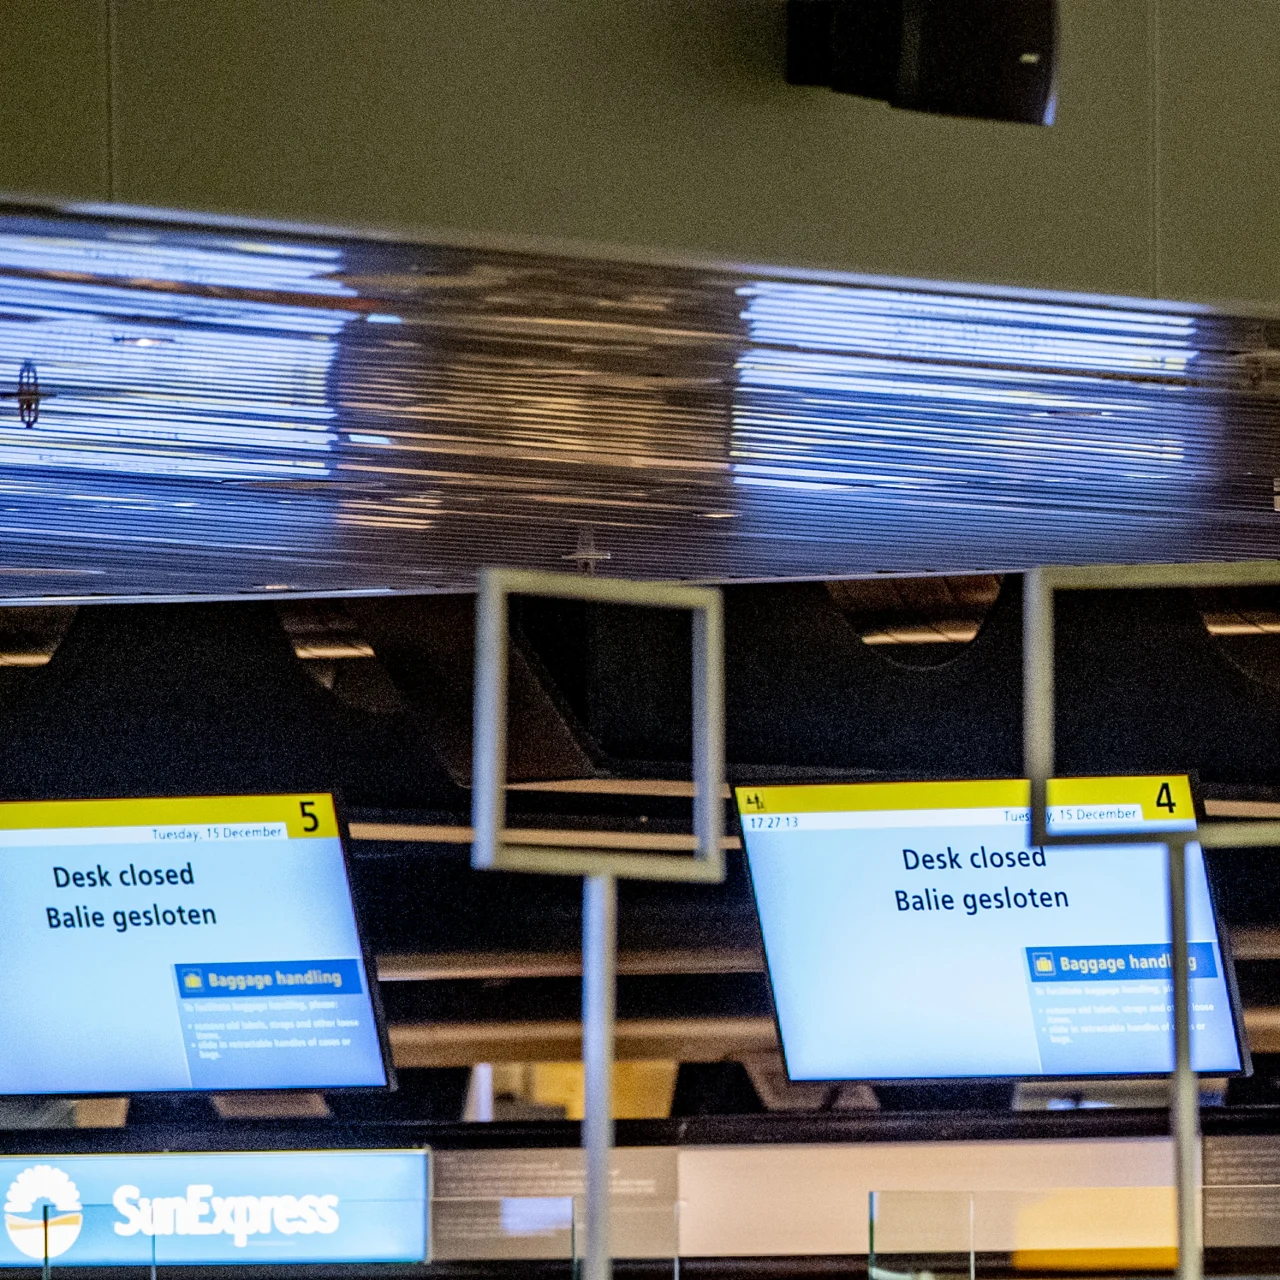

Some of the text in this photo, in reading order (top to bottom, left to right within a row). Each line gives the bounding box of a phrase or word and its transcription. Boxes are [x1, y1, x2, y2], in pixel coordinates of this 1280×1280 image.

[1155, 782, 1176, 814] 4
[299, 801, 319, 832] 5
[1004, 807, 1137, 823] Tuesy, 15 December
[207, 828, 220, 838] 15
[223, 827, 282, 838] December
[902, 845, 1047, 870] Desk closed
[53, 863, 195, 888] Desk closed
[894, 888, 1069, 916] Balie gesloten
[46, 904, 217, 932] Balie gesloten
[1060, 954, 1197, 973] Baggage handlg
[208, 970, 342, 989] Baggage handling
[114, 1184, 339, 1246] SunExpress
